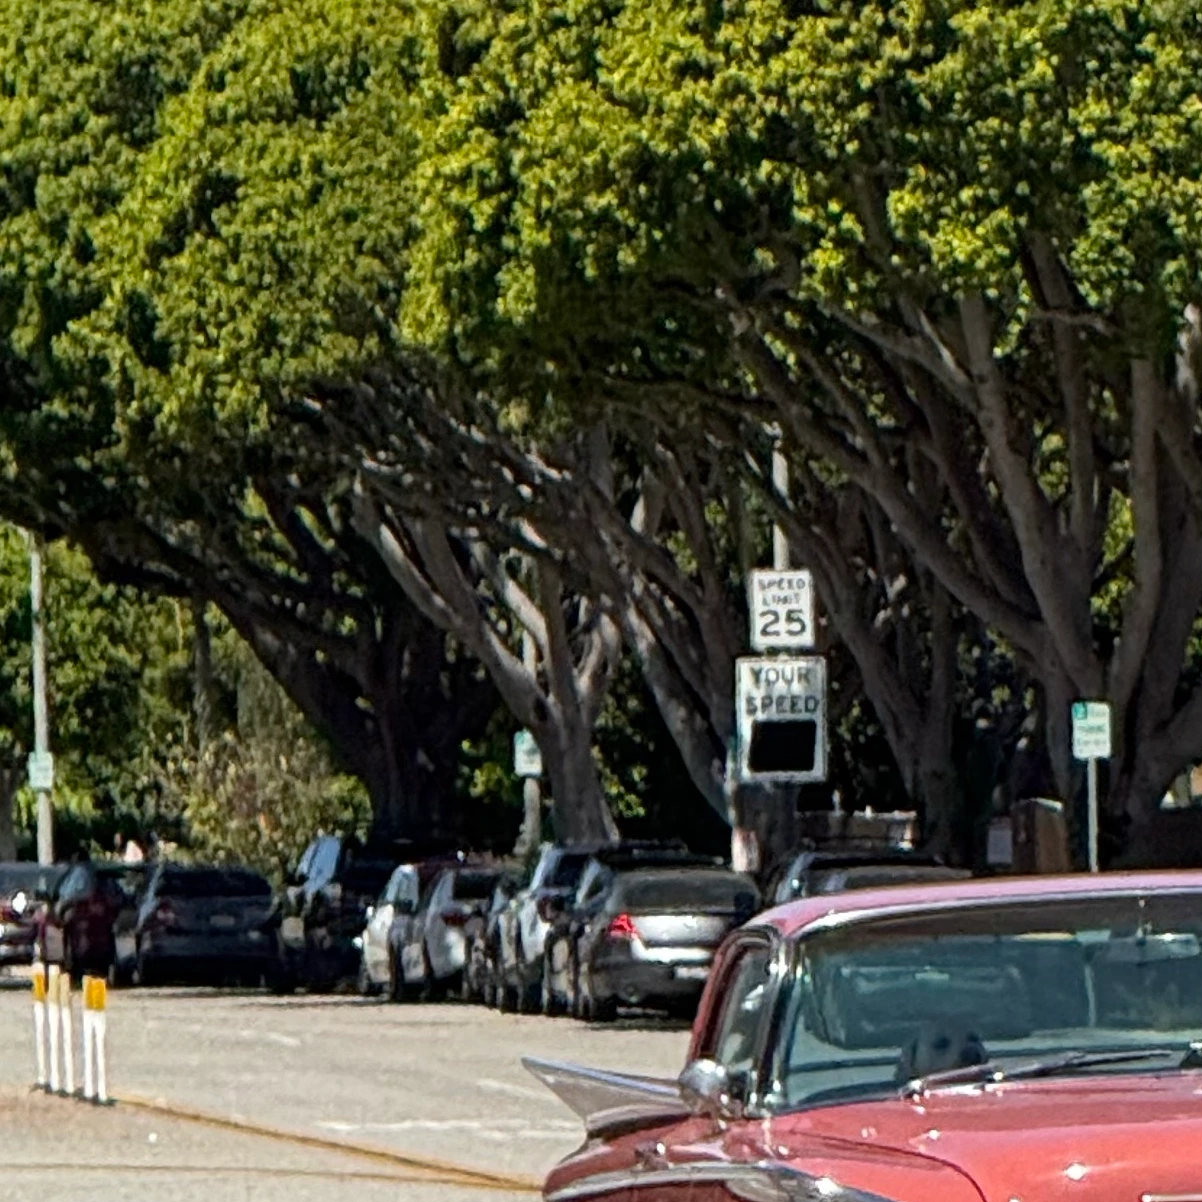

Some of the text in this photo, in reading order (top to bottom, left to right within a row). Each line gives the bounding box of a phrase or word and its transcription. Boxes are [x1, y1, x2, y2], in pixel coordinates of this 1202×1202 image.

[758, 578, 806, 590] SPEED
[762, 592, 801, 606] LIMIT
[759, 609, 807, 636] 25
[750, 666, 811, 689] YOUR
[745, 695, 820, 717] SPEED
